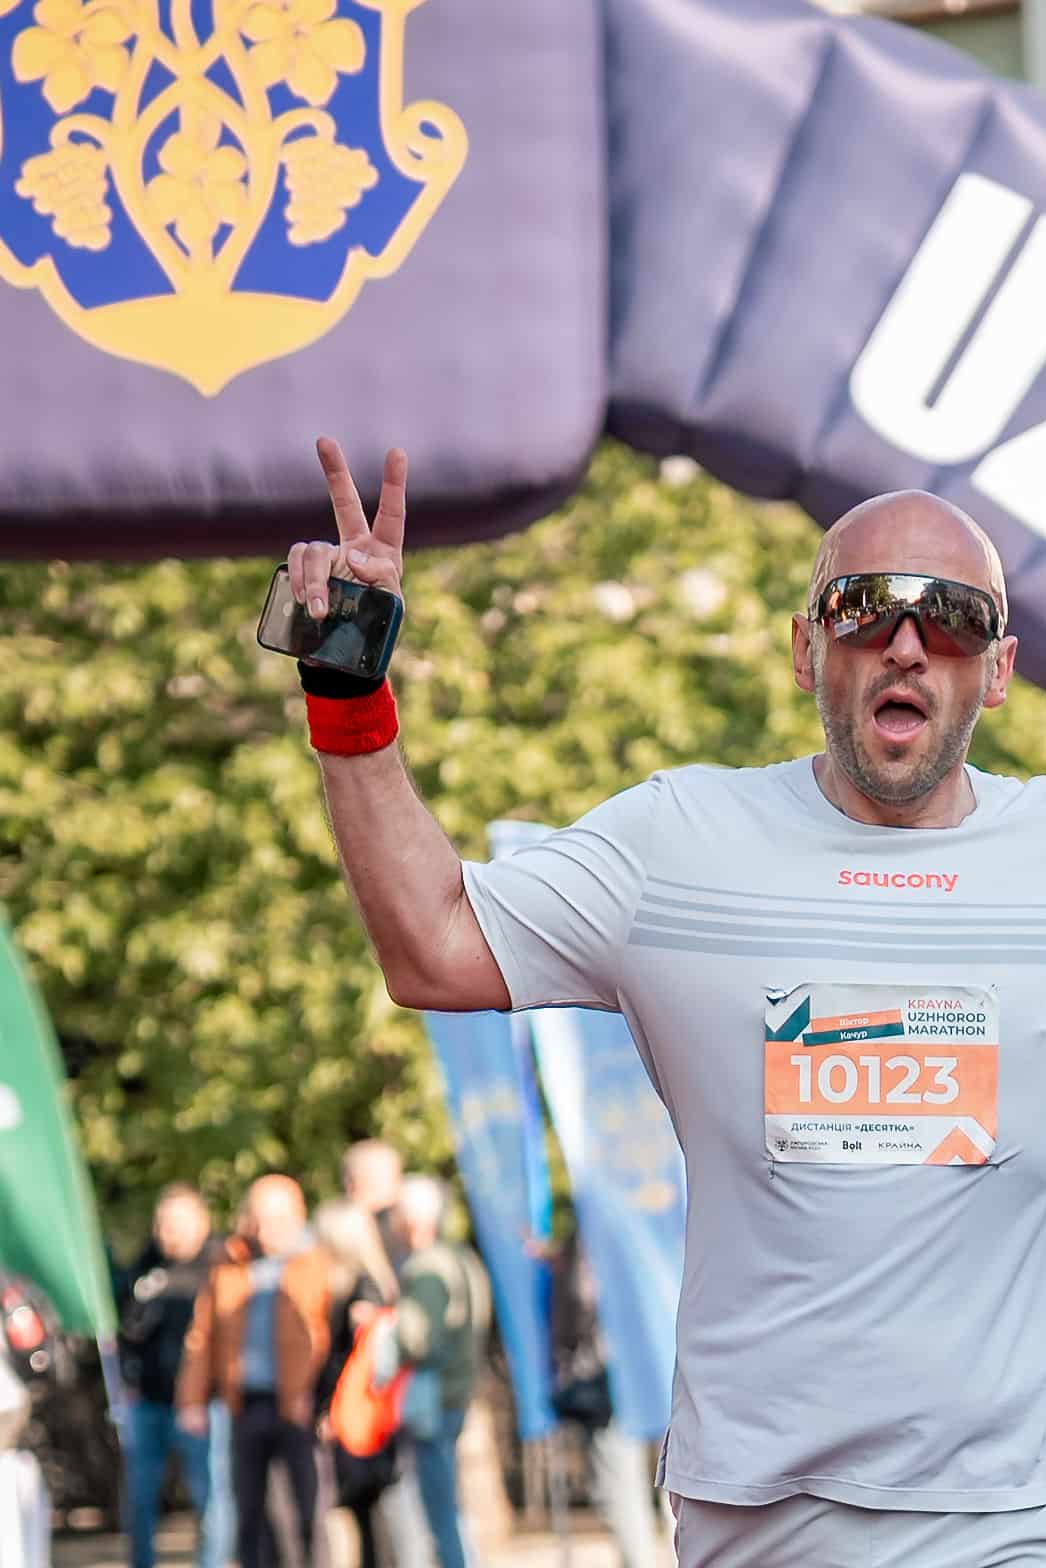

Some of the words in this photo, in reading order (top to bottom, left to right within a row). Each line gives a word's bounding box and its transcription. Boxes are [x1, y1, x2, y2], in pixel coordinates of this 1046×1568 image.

[838, 870, 958, 892] saucony
[908, 1000, 963, 1009] KRAYNA
[908, 1012, 986, 1022] UZHHOROD
[908, 1025, 986, 1036] MARATHON
[790, 1055, 960, 1105] 10123
[791, 1122, 852, 1132] ДИСТАНЦІЯ
[842, 1140, 862, 1151] Bolt
